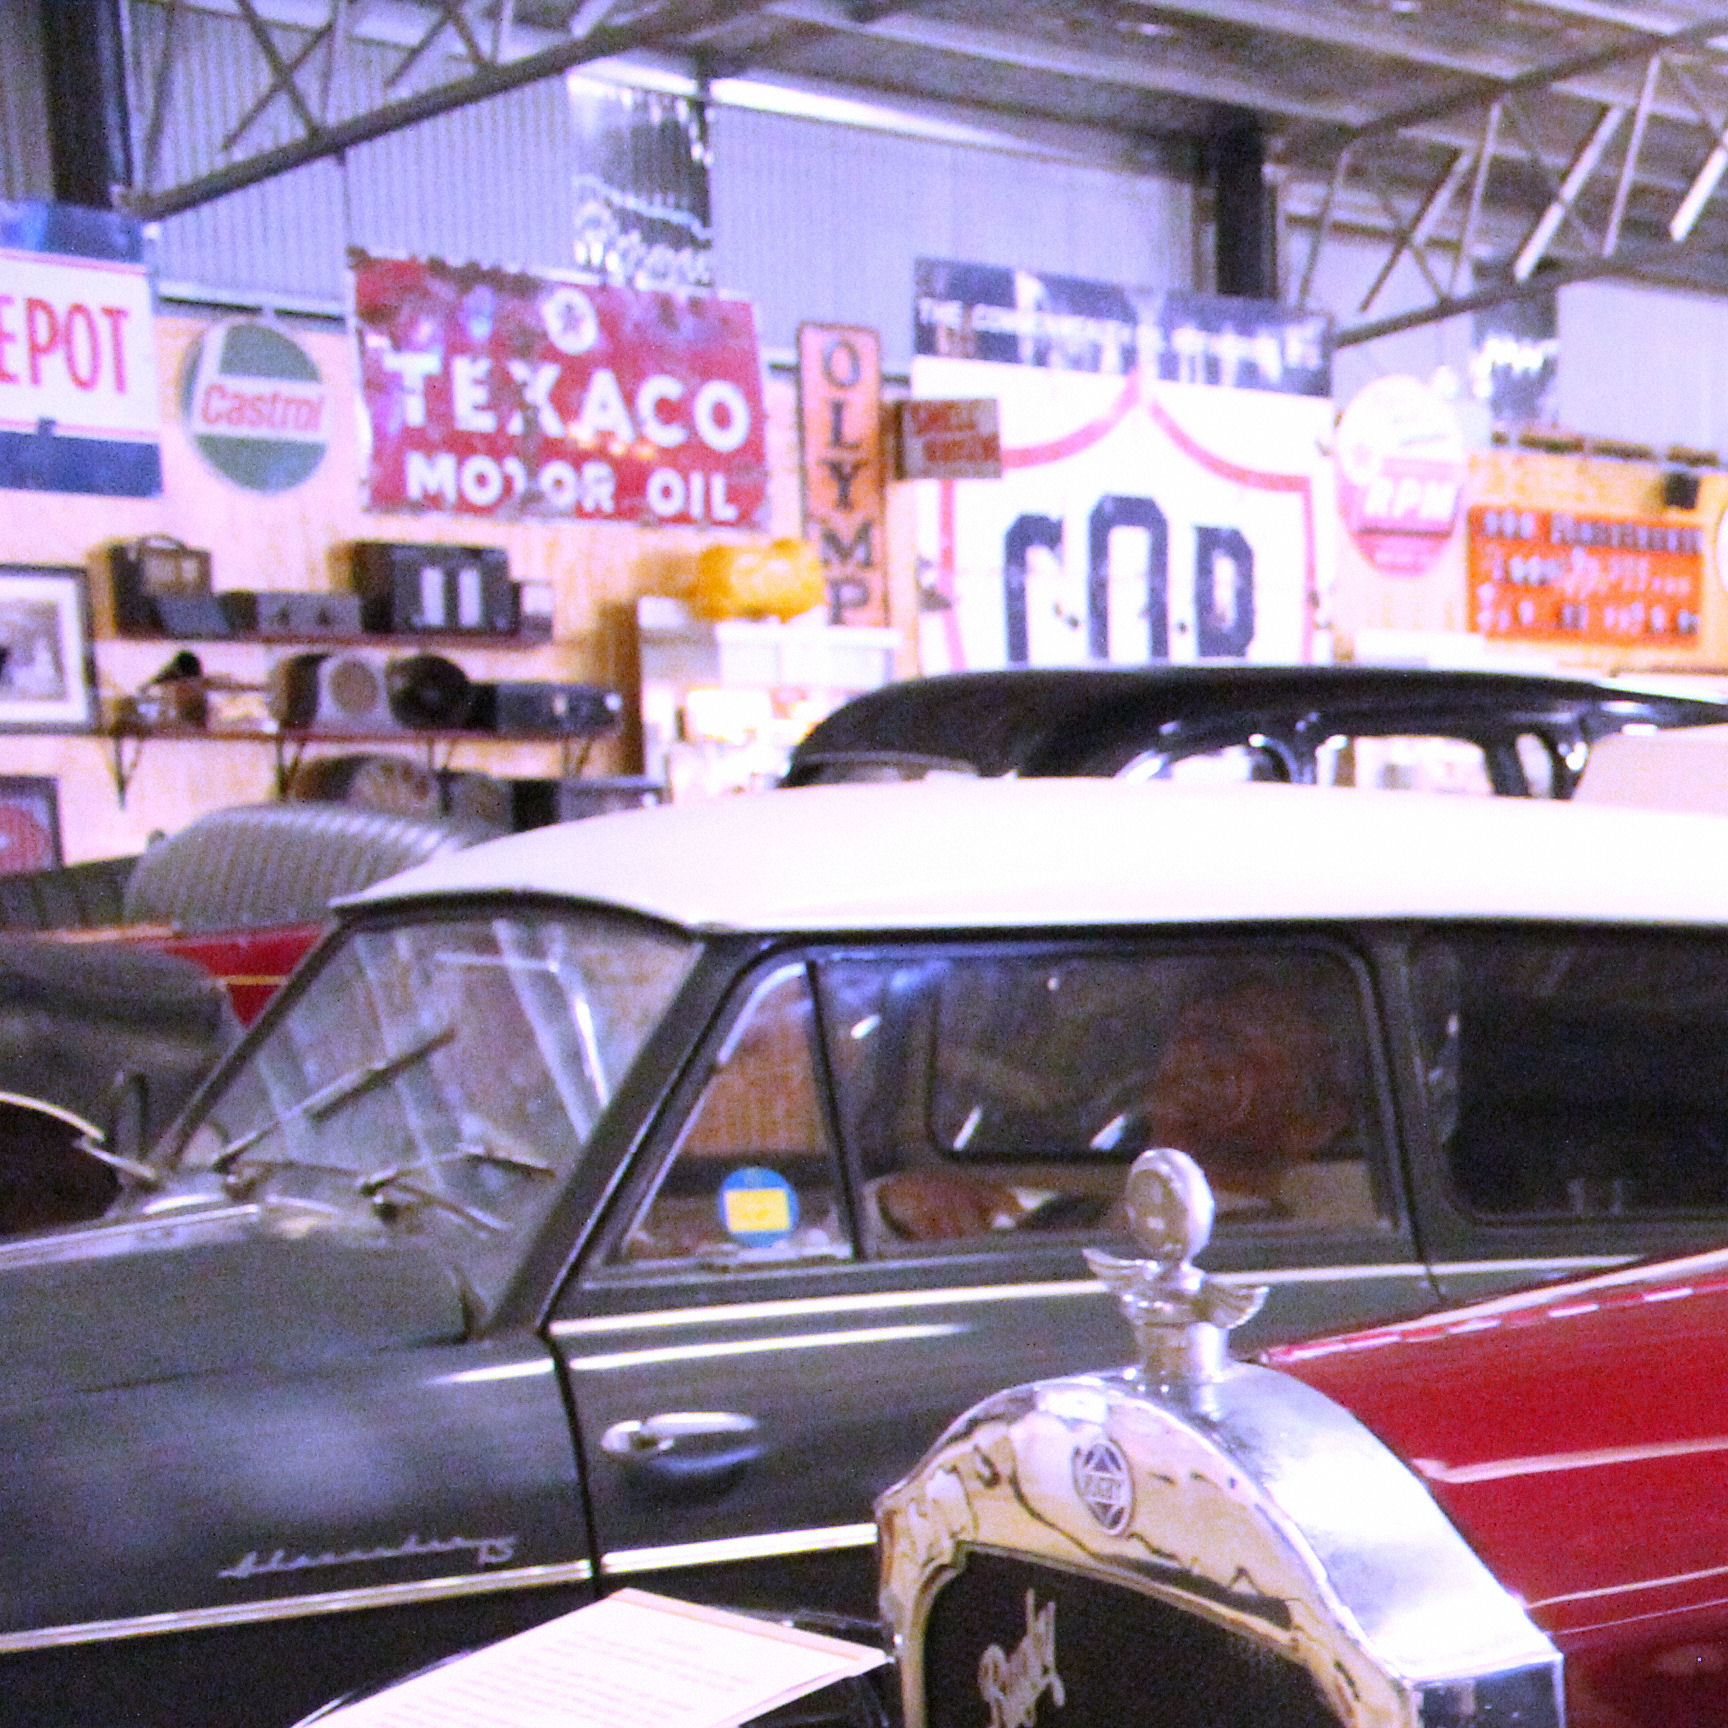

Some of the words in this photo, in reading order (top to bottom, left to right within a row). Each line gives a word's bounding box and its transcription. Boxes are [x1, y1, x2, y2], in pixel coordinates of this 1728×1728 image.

[199, 380, 327, 434] Castrol
[383, 344, 752, 453] TEXACO
[405, 450, 616, 515] MOTOR
[644, 465, 739, 524] OIL
[1376, 477, 1455, 517] RPM
